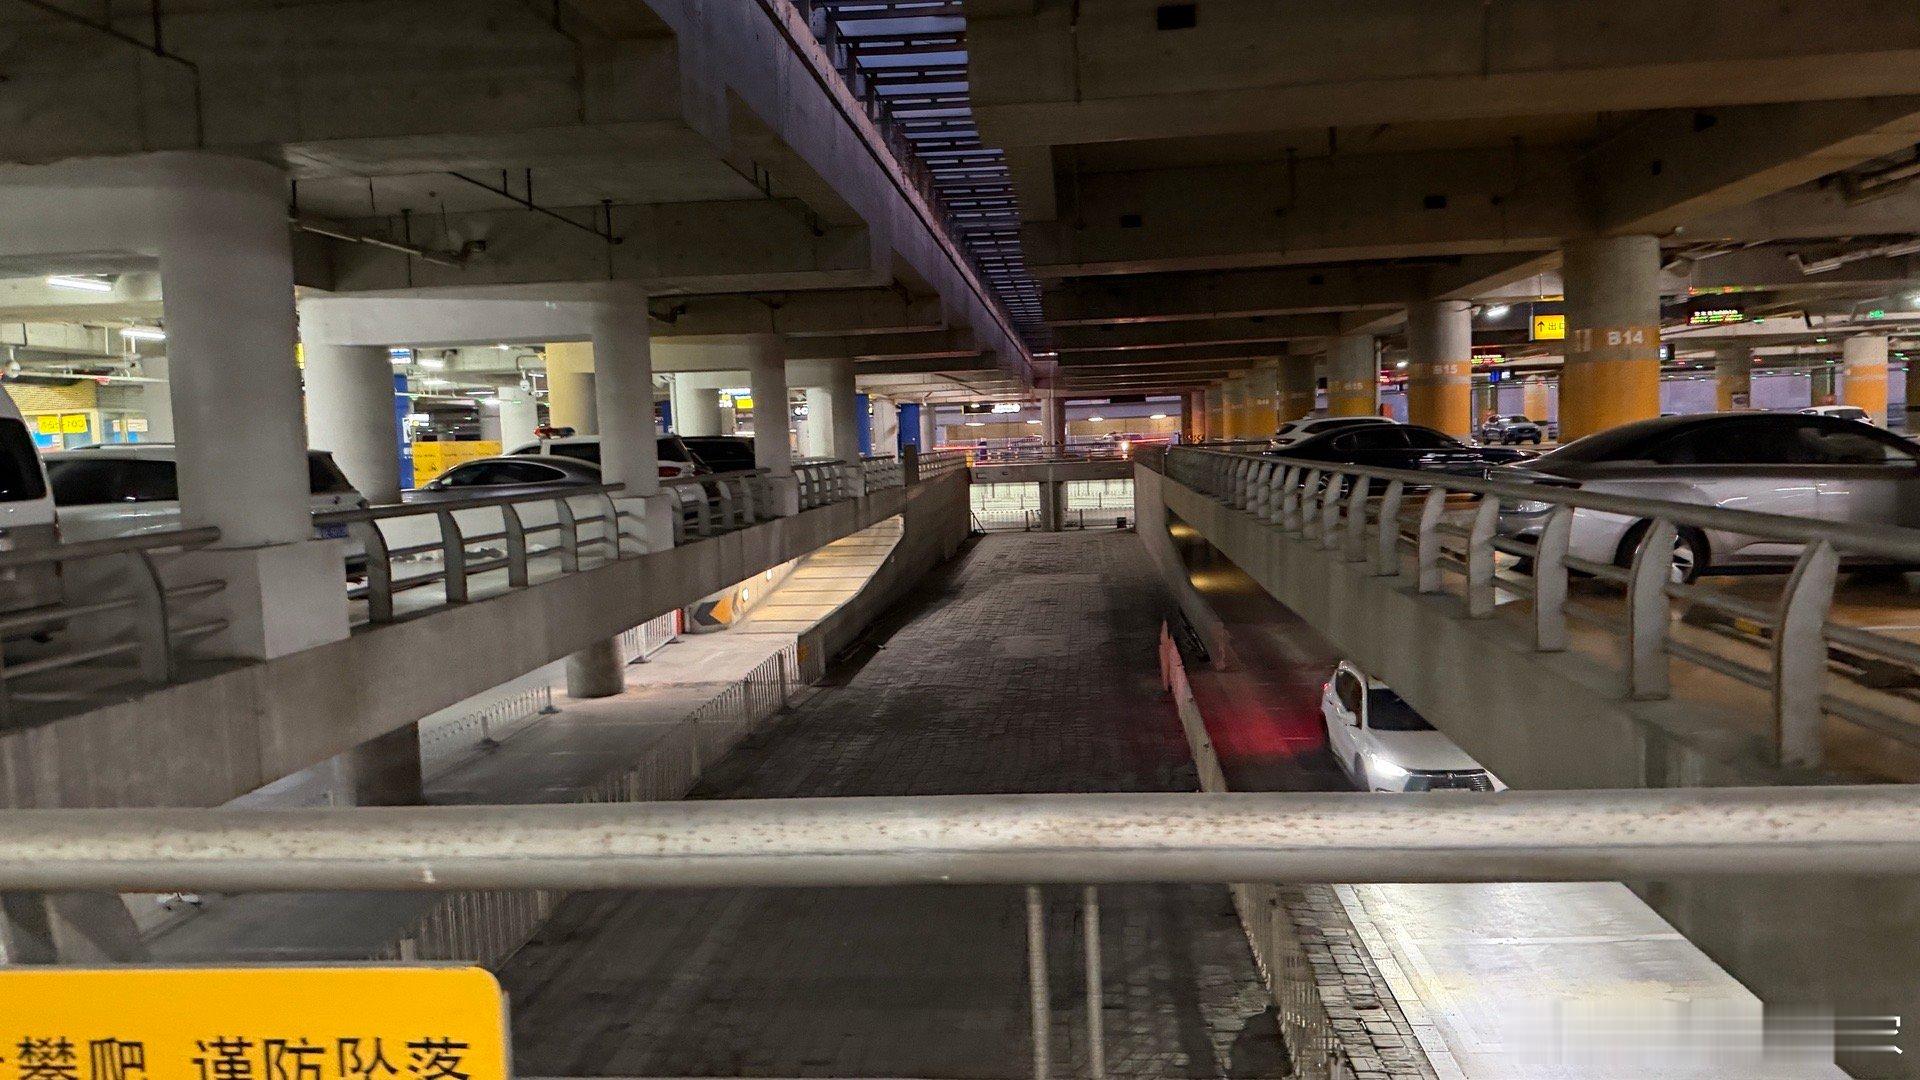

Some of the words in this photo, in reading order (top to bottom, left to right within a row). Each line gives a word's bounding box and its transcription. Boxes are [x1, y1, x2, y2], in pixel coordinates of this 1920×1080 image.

[1548, 322, 1565, 331] 出口
[1608, 330, 1645, 346] B14
[0, 1036, 148, 1080] 攀爬
[192, 1035, 470, 1080] 谨防坠落
